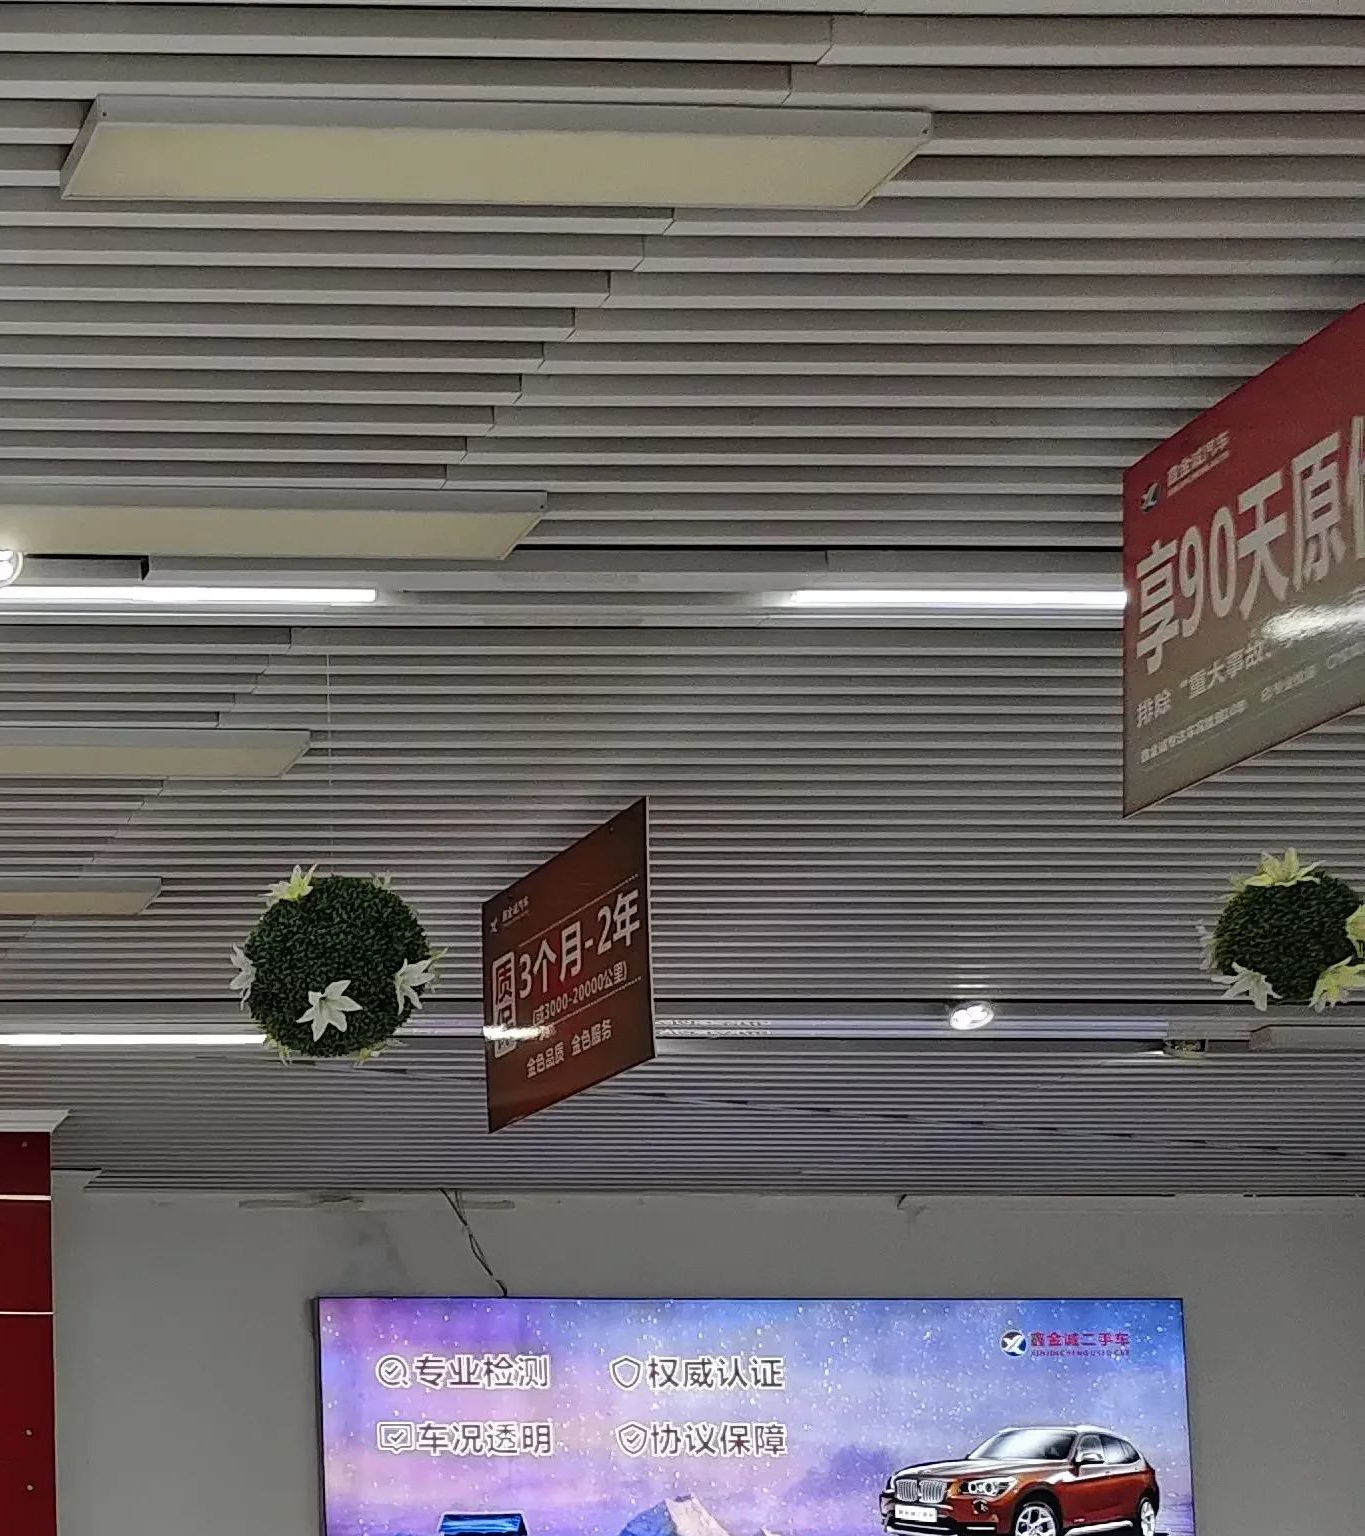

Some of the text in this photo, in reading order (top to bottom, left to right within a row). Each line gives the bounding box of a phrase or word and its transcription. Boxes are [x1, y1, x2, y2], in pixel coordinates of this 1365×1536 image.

[519, 888, 641, 1000] 3个月-2年
[526, 1018, 613, 1080] 金色品质 金色服务
[413, 1355, 785, 1390] 专业检测 权威认证
[416, 1421, 787, 1457] 车况透明 协议保障
